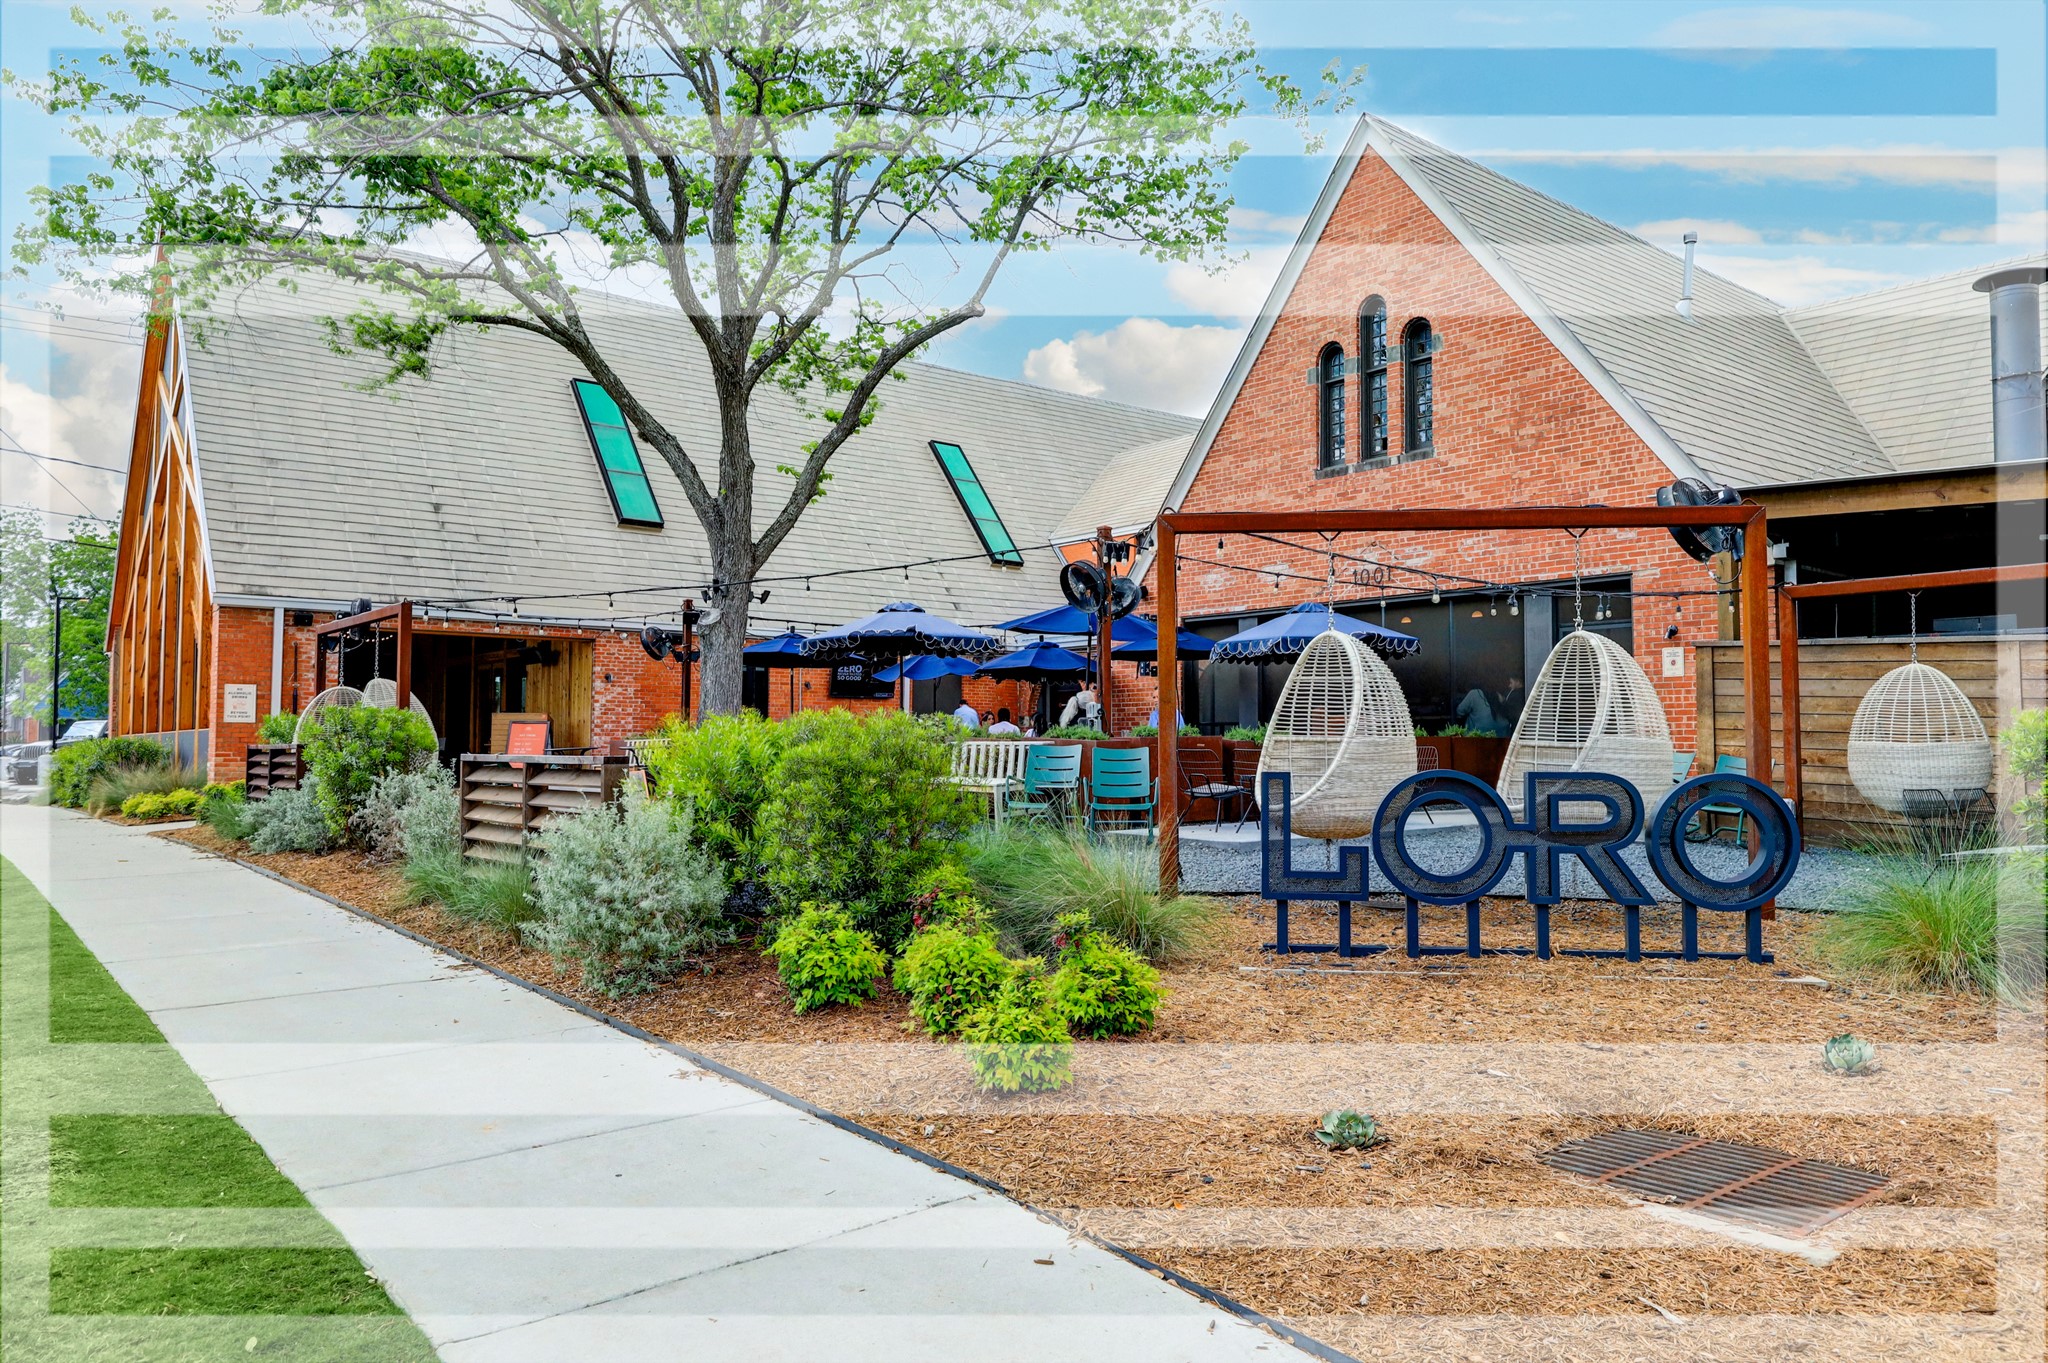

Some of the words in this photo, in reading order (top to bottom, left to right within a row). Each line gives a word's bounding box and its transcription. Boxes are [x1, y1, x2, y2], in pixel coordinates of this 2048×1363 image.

[1353, 566, 1391, 585] 1001
[838, 664, 862, 672] ZERO
[1261, 769, 1801, 911] LORO
